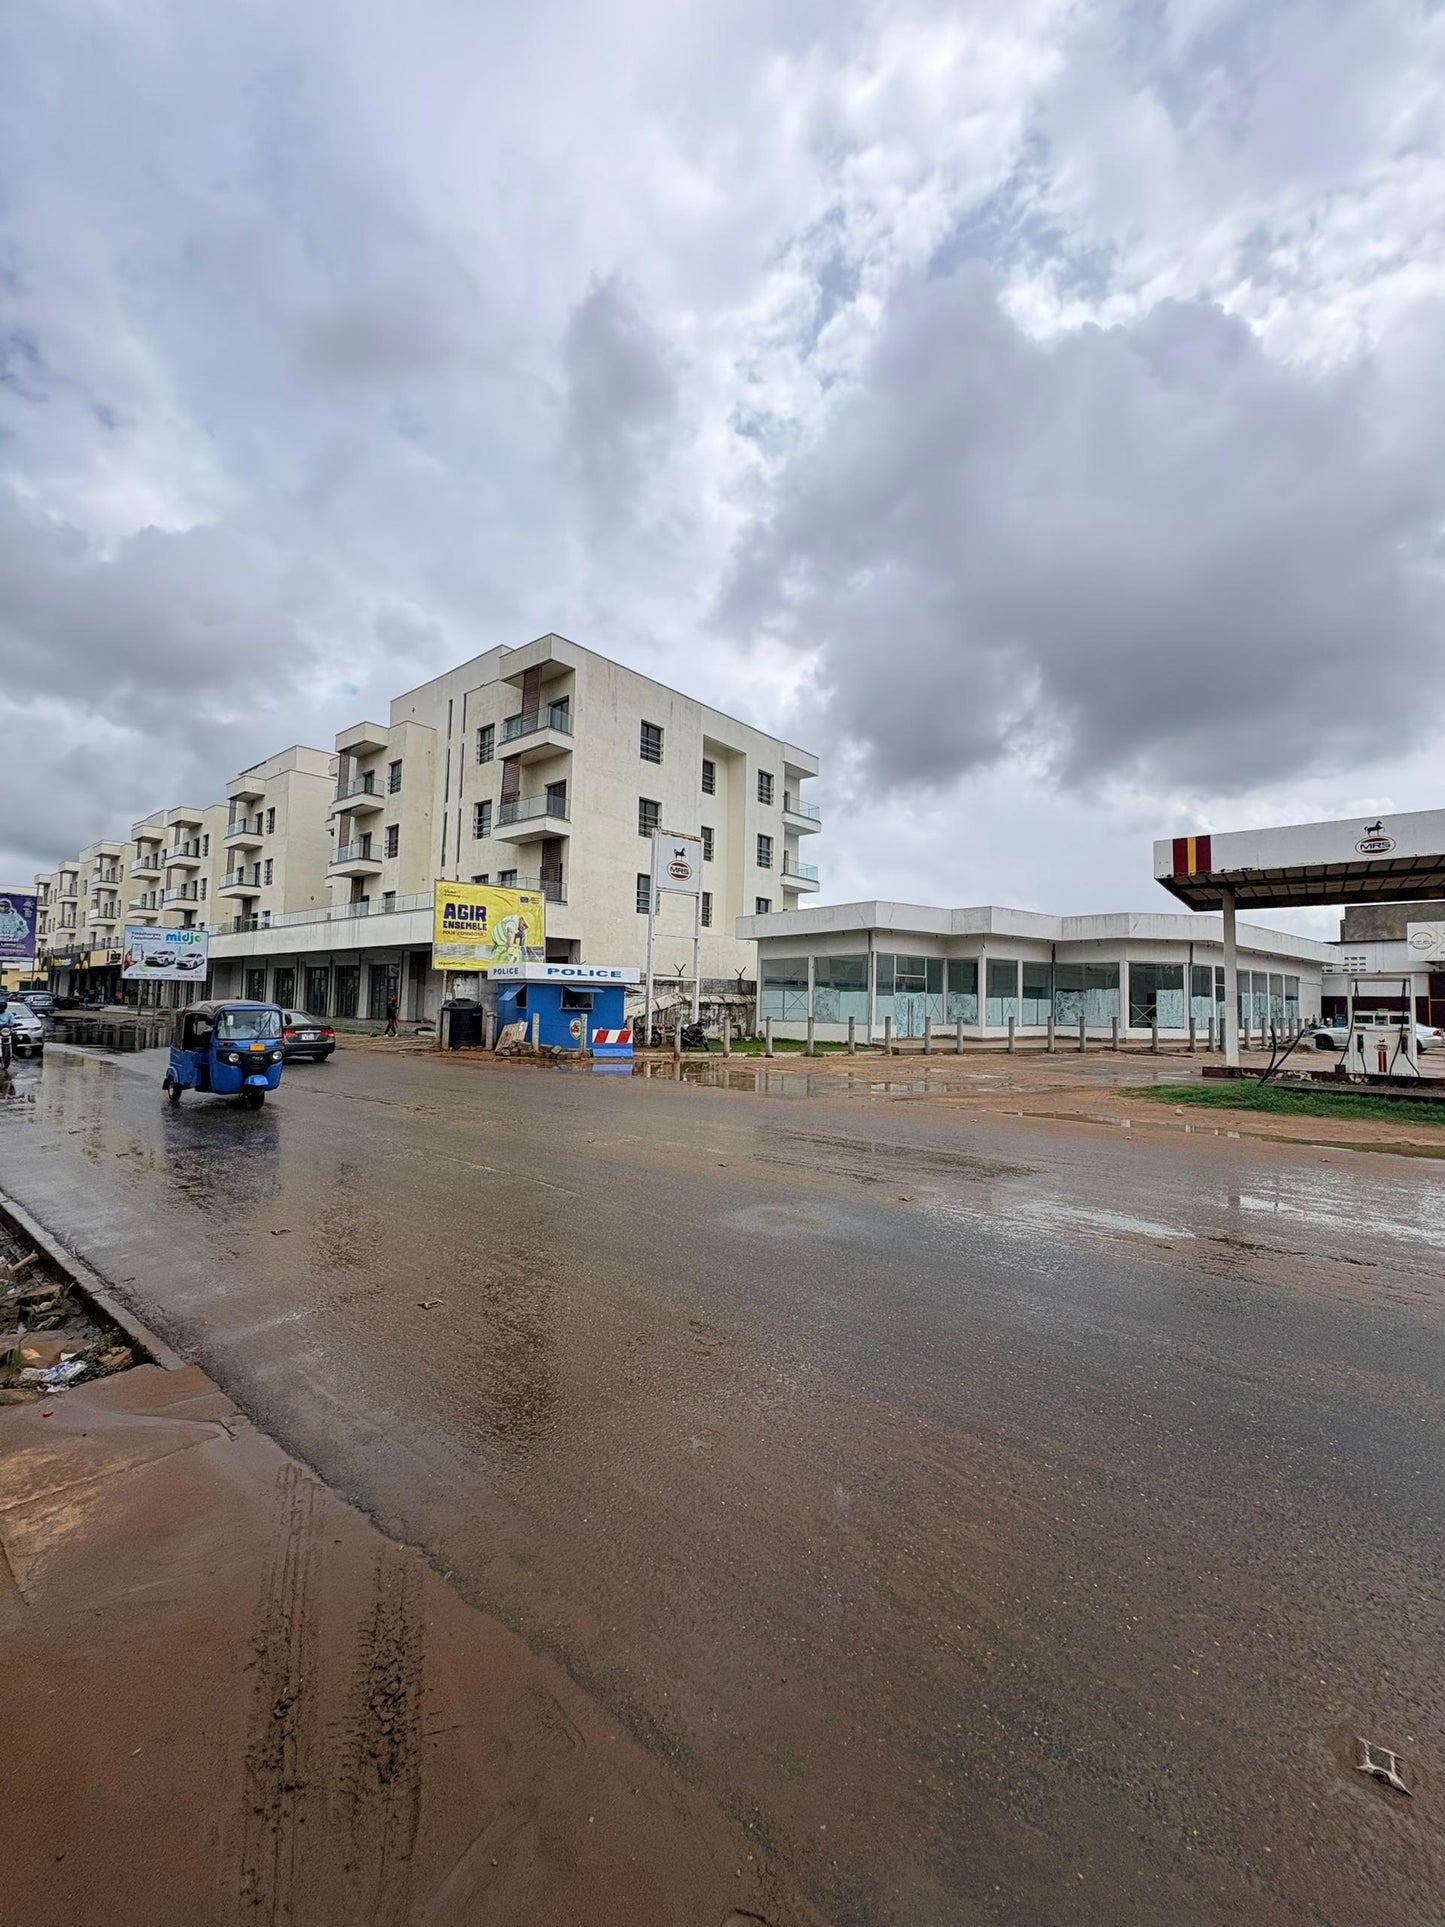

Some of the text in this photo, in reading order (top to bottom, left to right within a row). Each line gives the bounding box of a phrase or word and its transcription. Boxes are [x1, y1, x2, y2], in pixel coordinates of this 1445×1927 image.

[1360, 841, 1390, 850] MRS
[669, 866, 689, 875] MRS
[443, 902, 487, 922] AGIR
[442, 920, 487, 931] ENSEMBLE
[166, 931, 202, 945] midjo
[493, 967, 519, 975] POLICE
[547, 967, 622, 978] POLICE
